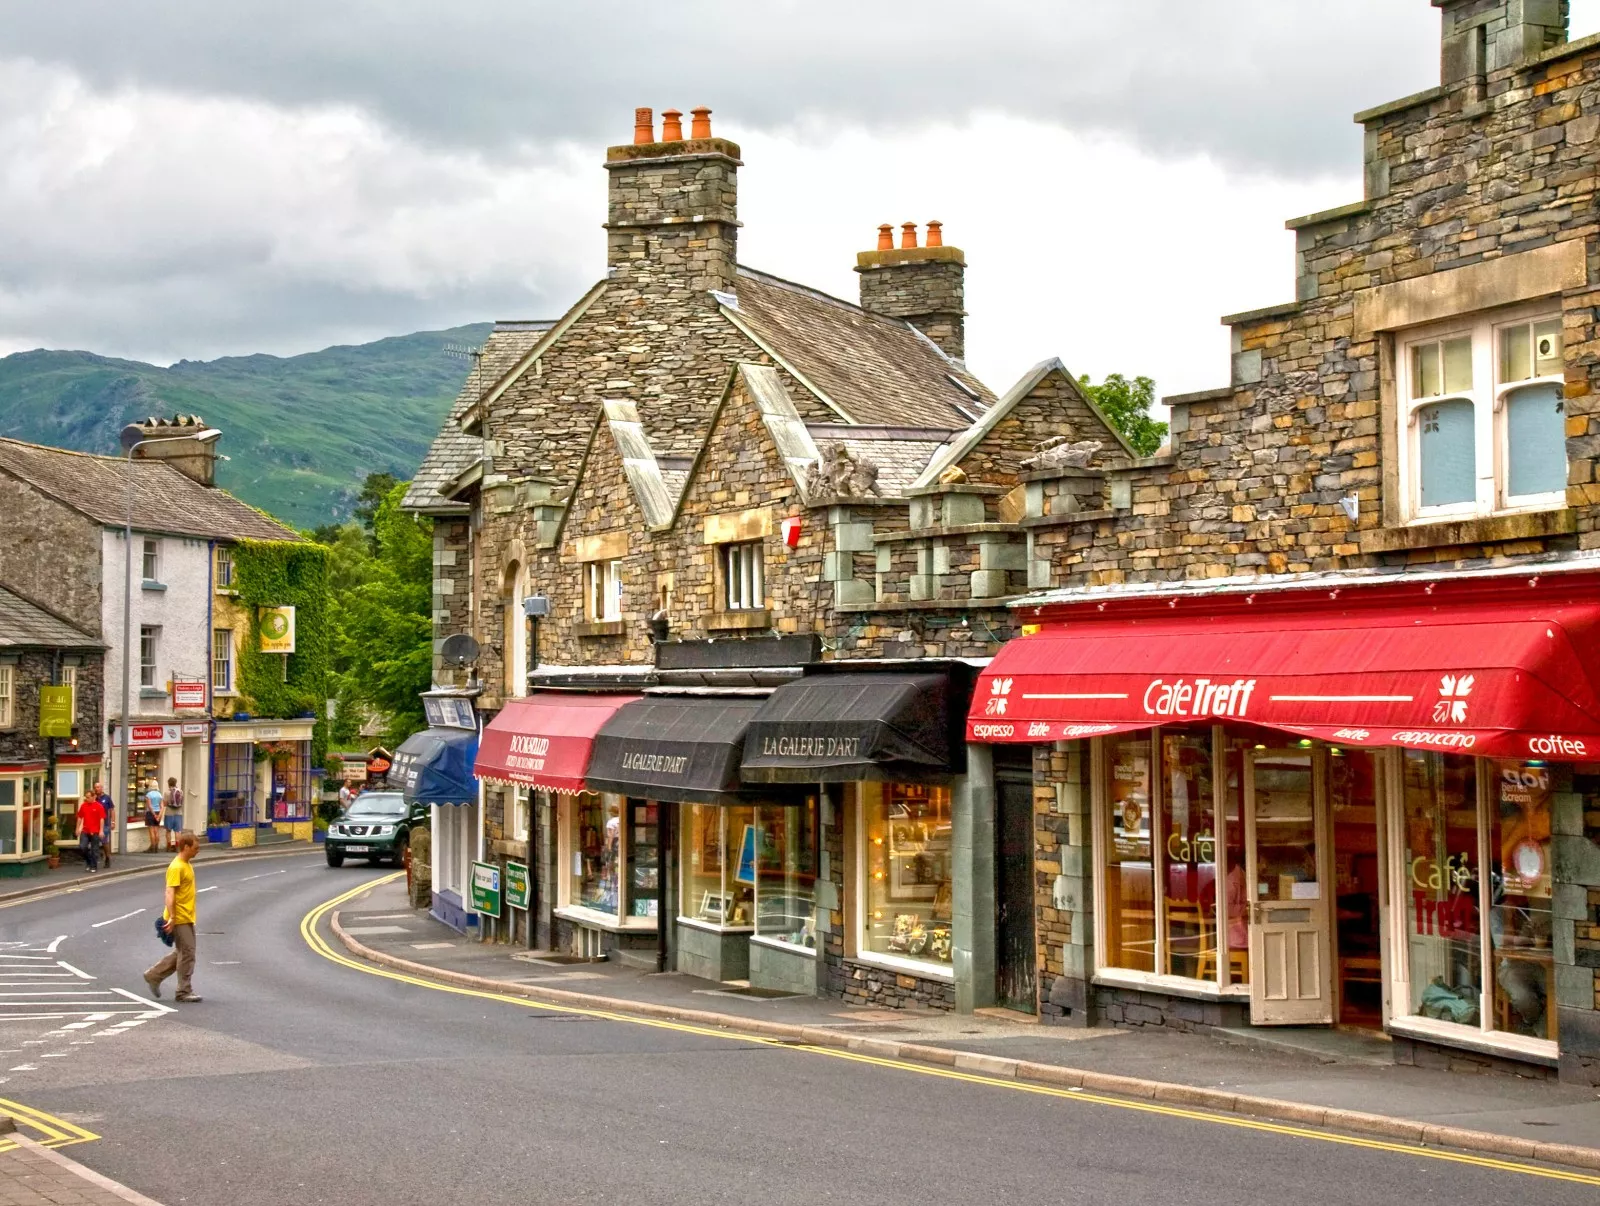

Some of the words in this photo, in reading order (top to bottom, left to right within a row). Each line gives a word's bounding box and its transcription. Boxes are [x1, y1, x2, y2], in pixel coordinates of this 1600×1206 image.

[1192, 679, 1257, 716] Treff
[973, 724, 1014, 739] espresso
[1027, 722, 1050, 737] latte
[1333, 728, 1370, 741] latte
[763, 737, 777, 755] LA
[779, 736, 824, 756] GALERIE
[827, 737, 860, 756] D'ART
[1392, 731, 1476, 748] cappuccino
[1529, 735, 1586, 755] coffee
[622, 752, 633, 769] LA
[632, 753, 665, 771] GALERIE
